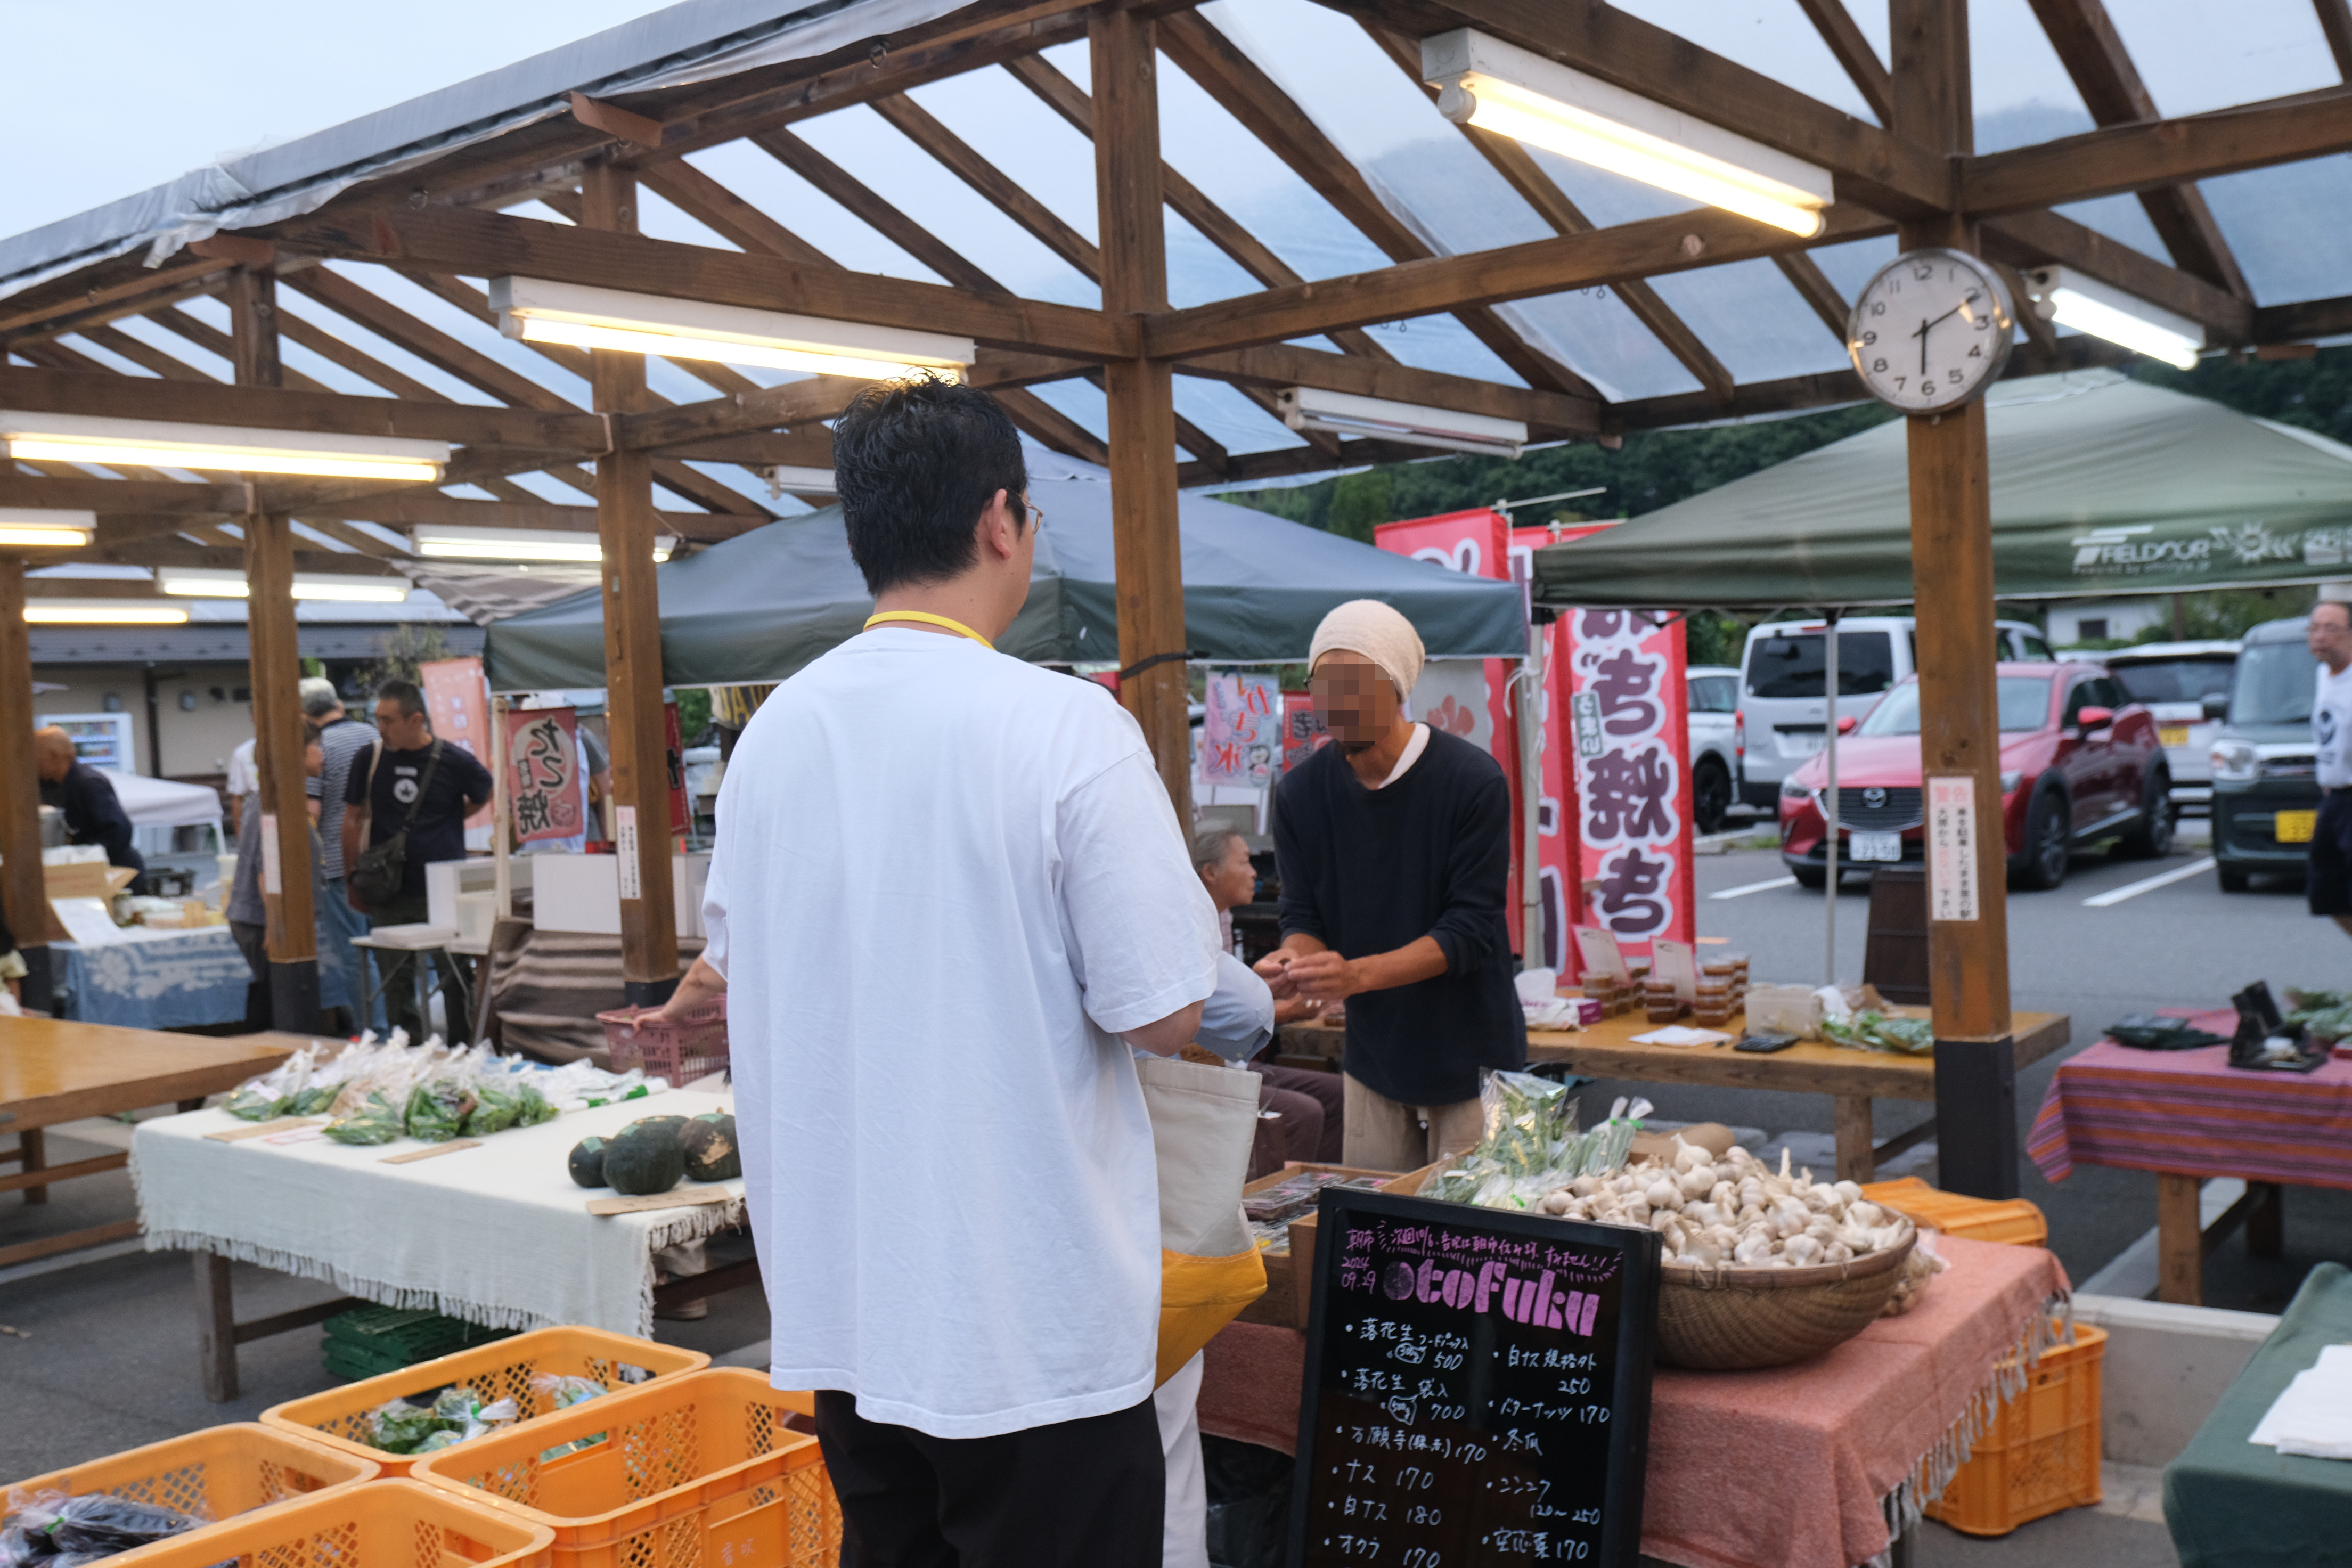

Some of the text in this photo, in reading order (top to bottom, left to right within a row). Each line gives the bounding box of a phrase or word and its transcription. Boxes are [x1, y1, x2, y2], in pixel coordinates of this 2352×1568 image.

[1913, 266, 1932, 280] 12
[1948, 268, 1954, 282] 1
[1889, 280, 1901, 294] 11
[1870, 301, 1887, 317] 10
[1974, 315, 1989, 330] 3
[1863, 331, 1877, 345] 9
[1967, 344, 1981, 358] 4
[1873, 357, 1888, 373] 8
[1893, 377, 1907, 391] 7
[1948, 369, 1964, 384] 5
[1920, 380, 1936, 396] 6
[1433, 1351, 1463, 1370] 500
[1558, 1377, 1590, 1394] 250
[1431, 1403, 1465, 1420] 700
[1580, 1404, 1610, 1424] 170
[1503, 1428, 1543, 1456] 冬瓜
[1455, 1443, 1487, 1464] 170
[1346, 1459, 1432, 1490] ナス 170
[1407, 1505, 1441, 1525] 180
[1403, 1547, 1440, 1568] 170
[1557, 1539, 1588, 1560] 170
